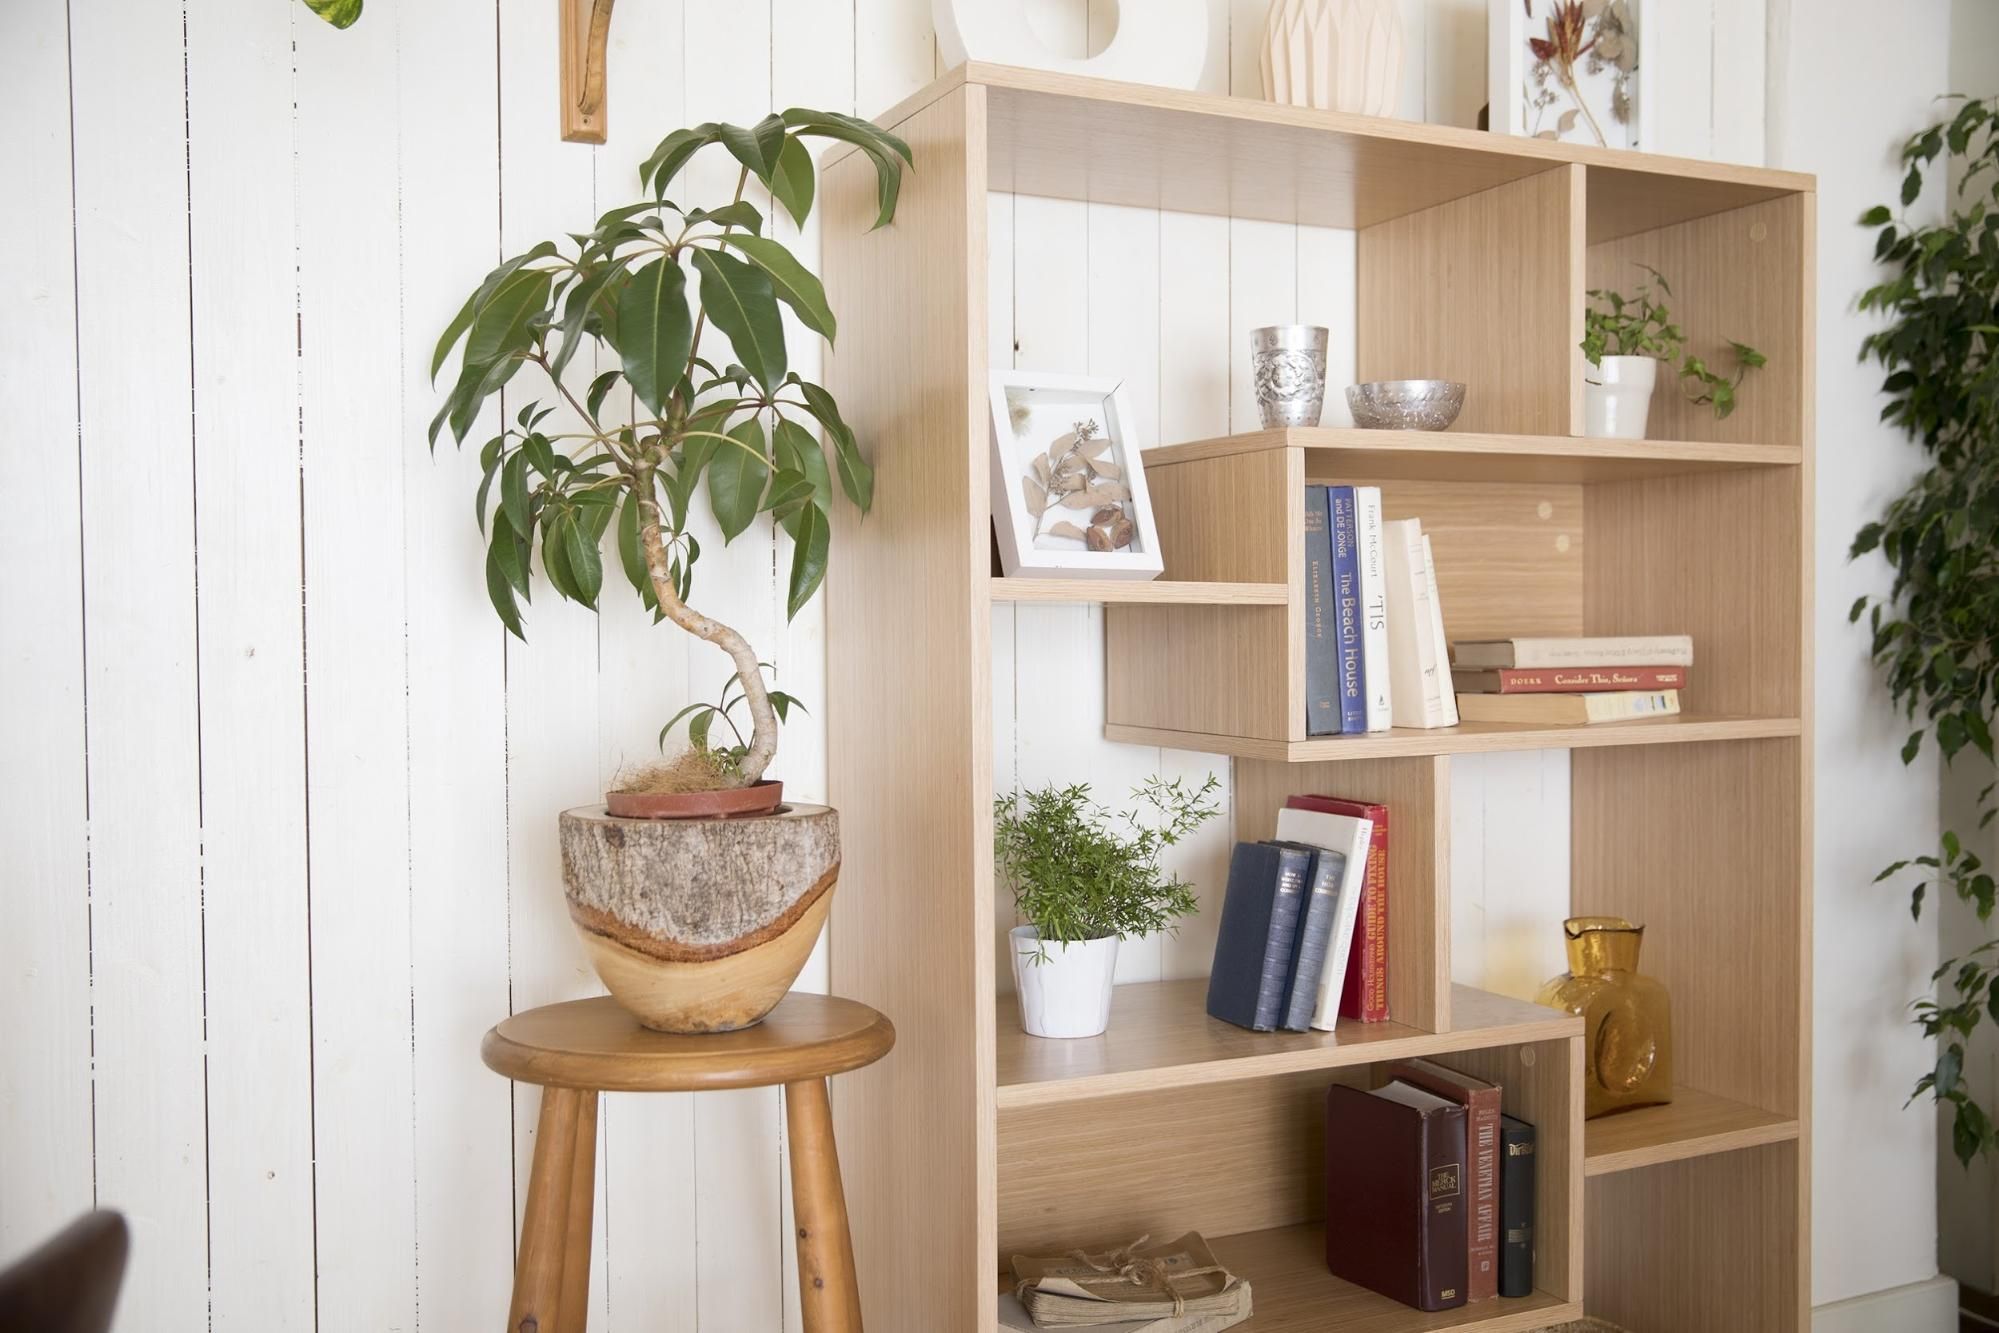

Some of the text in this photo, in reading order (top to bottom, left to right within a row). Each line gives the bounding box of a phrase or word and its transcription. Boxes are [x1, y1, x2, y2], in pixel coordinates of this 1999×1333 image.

[1335, 498, 1347, 558] and DE JONGE
[1345, 498, 1355, 548] PATTERSON
[1368, 504, 1378, 577] Frank McCourt
[1341, 572, 1352, 595] The
[1342, 597, 1358, 644] Beach
[1344, 648, 1359, 697] House
[1554, 674, 1588, 685] Consider
[1589, 674, 1612, 684] This,
[1367, 844, 1377, 884] FIXING
[1367, 886, 1377, 903] TO
[1367, 904, 1377, 940] GUIDE
[1376, 849, 1386, 1011] THINGS AROUND THE HOUSE
[1478, 1123, 1494, 1147] THE
[1478, 1149, 1493, 1201] VENETIAN
[1477, 1204, 1493, 1242] AFFAIR
